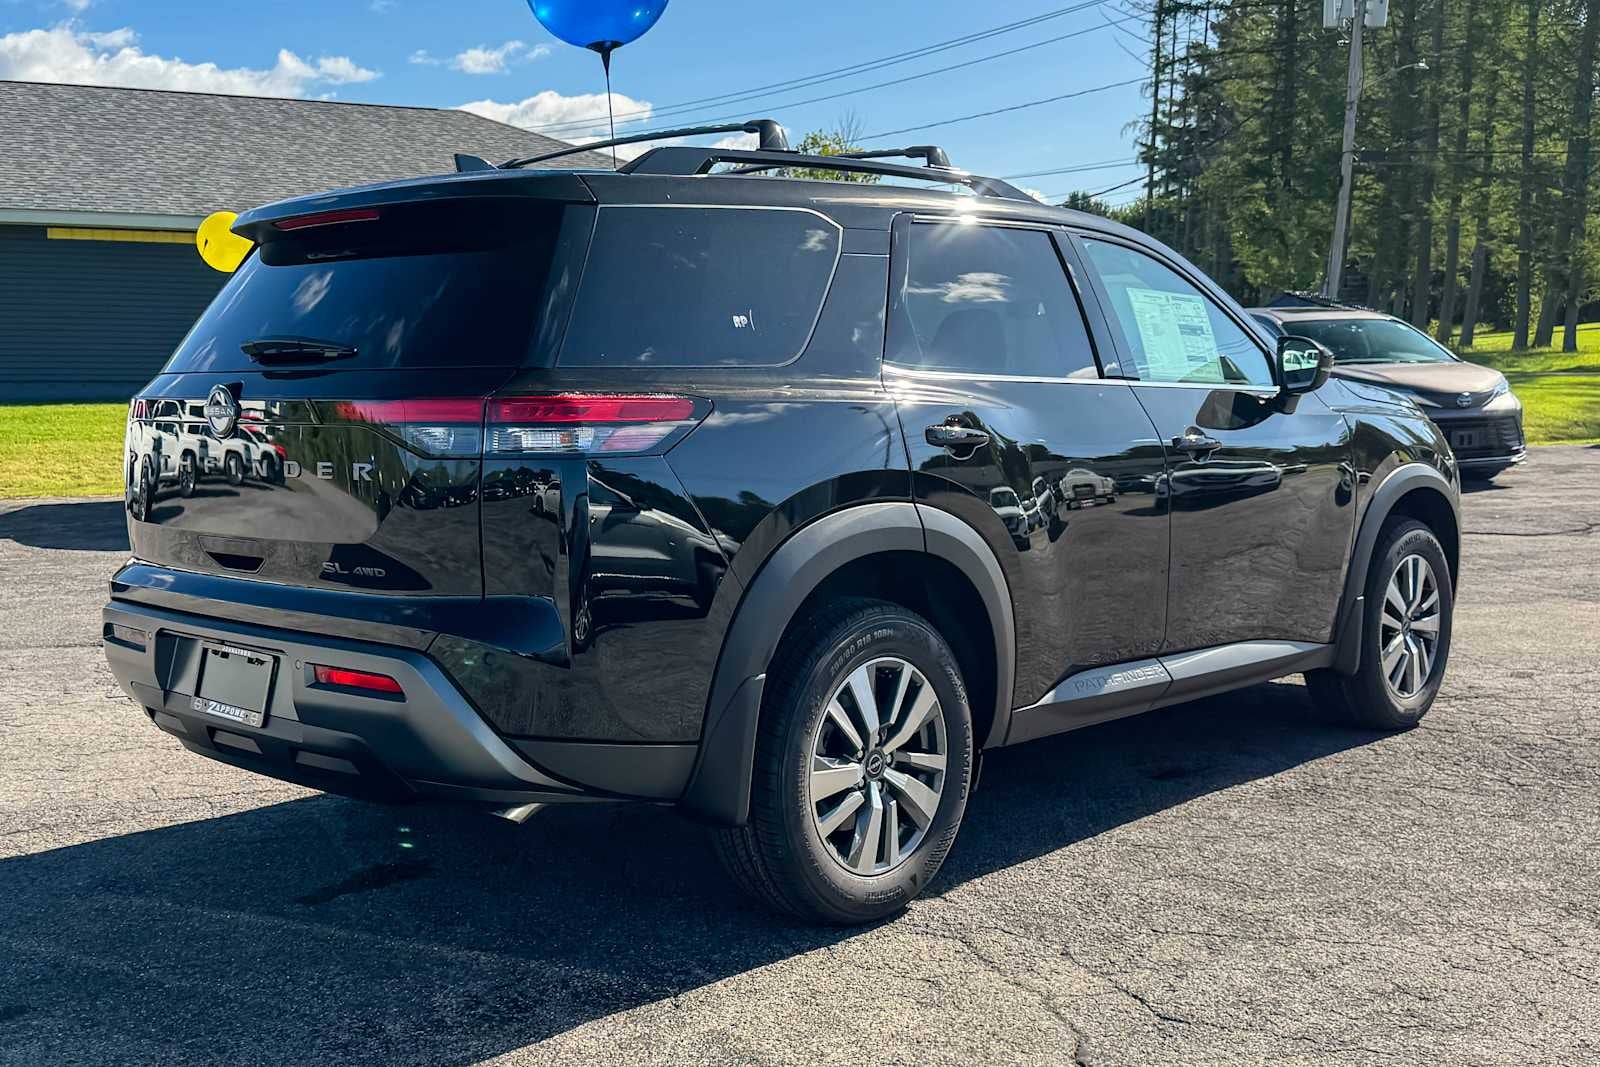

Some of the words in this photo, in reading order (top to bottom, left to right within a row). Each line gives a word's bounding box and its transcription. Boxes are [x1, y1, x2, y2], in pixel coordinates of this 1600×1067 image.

[205, 407, 235, 416] ISSAN
[129, 449, 375, 482] PATHFINDER
[322, 561, 349, 574] SL
